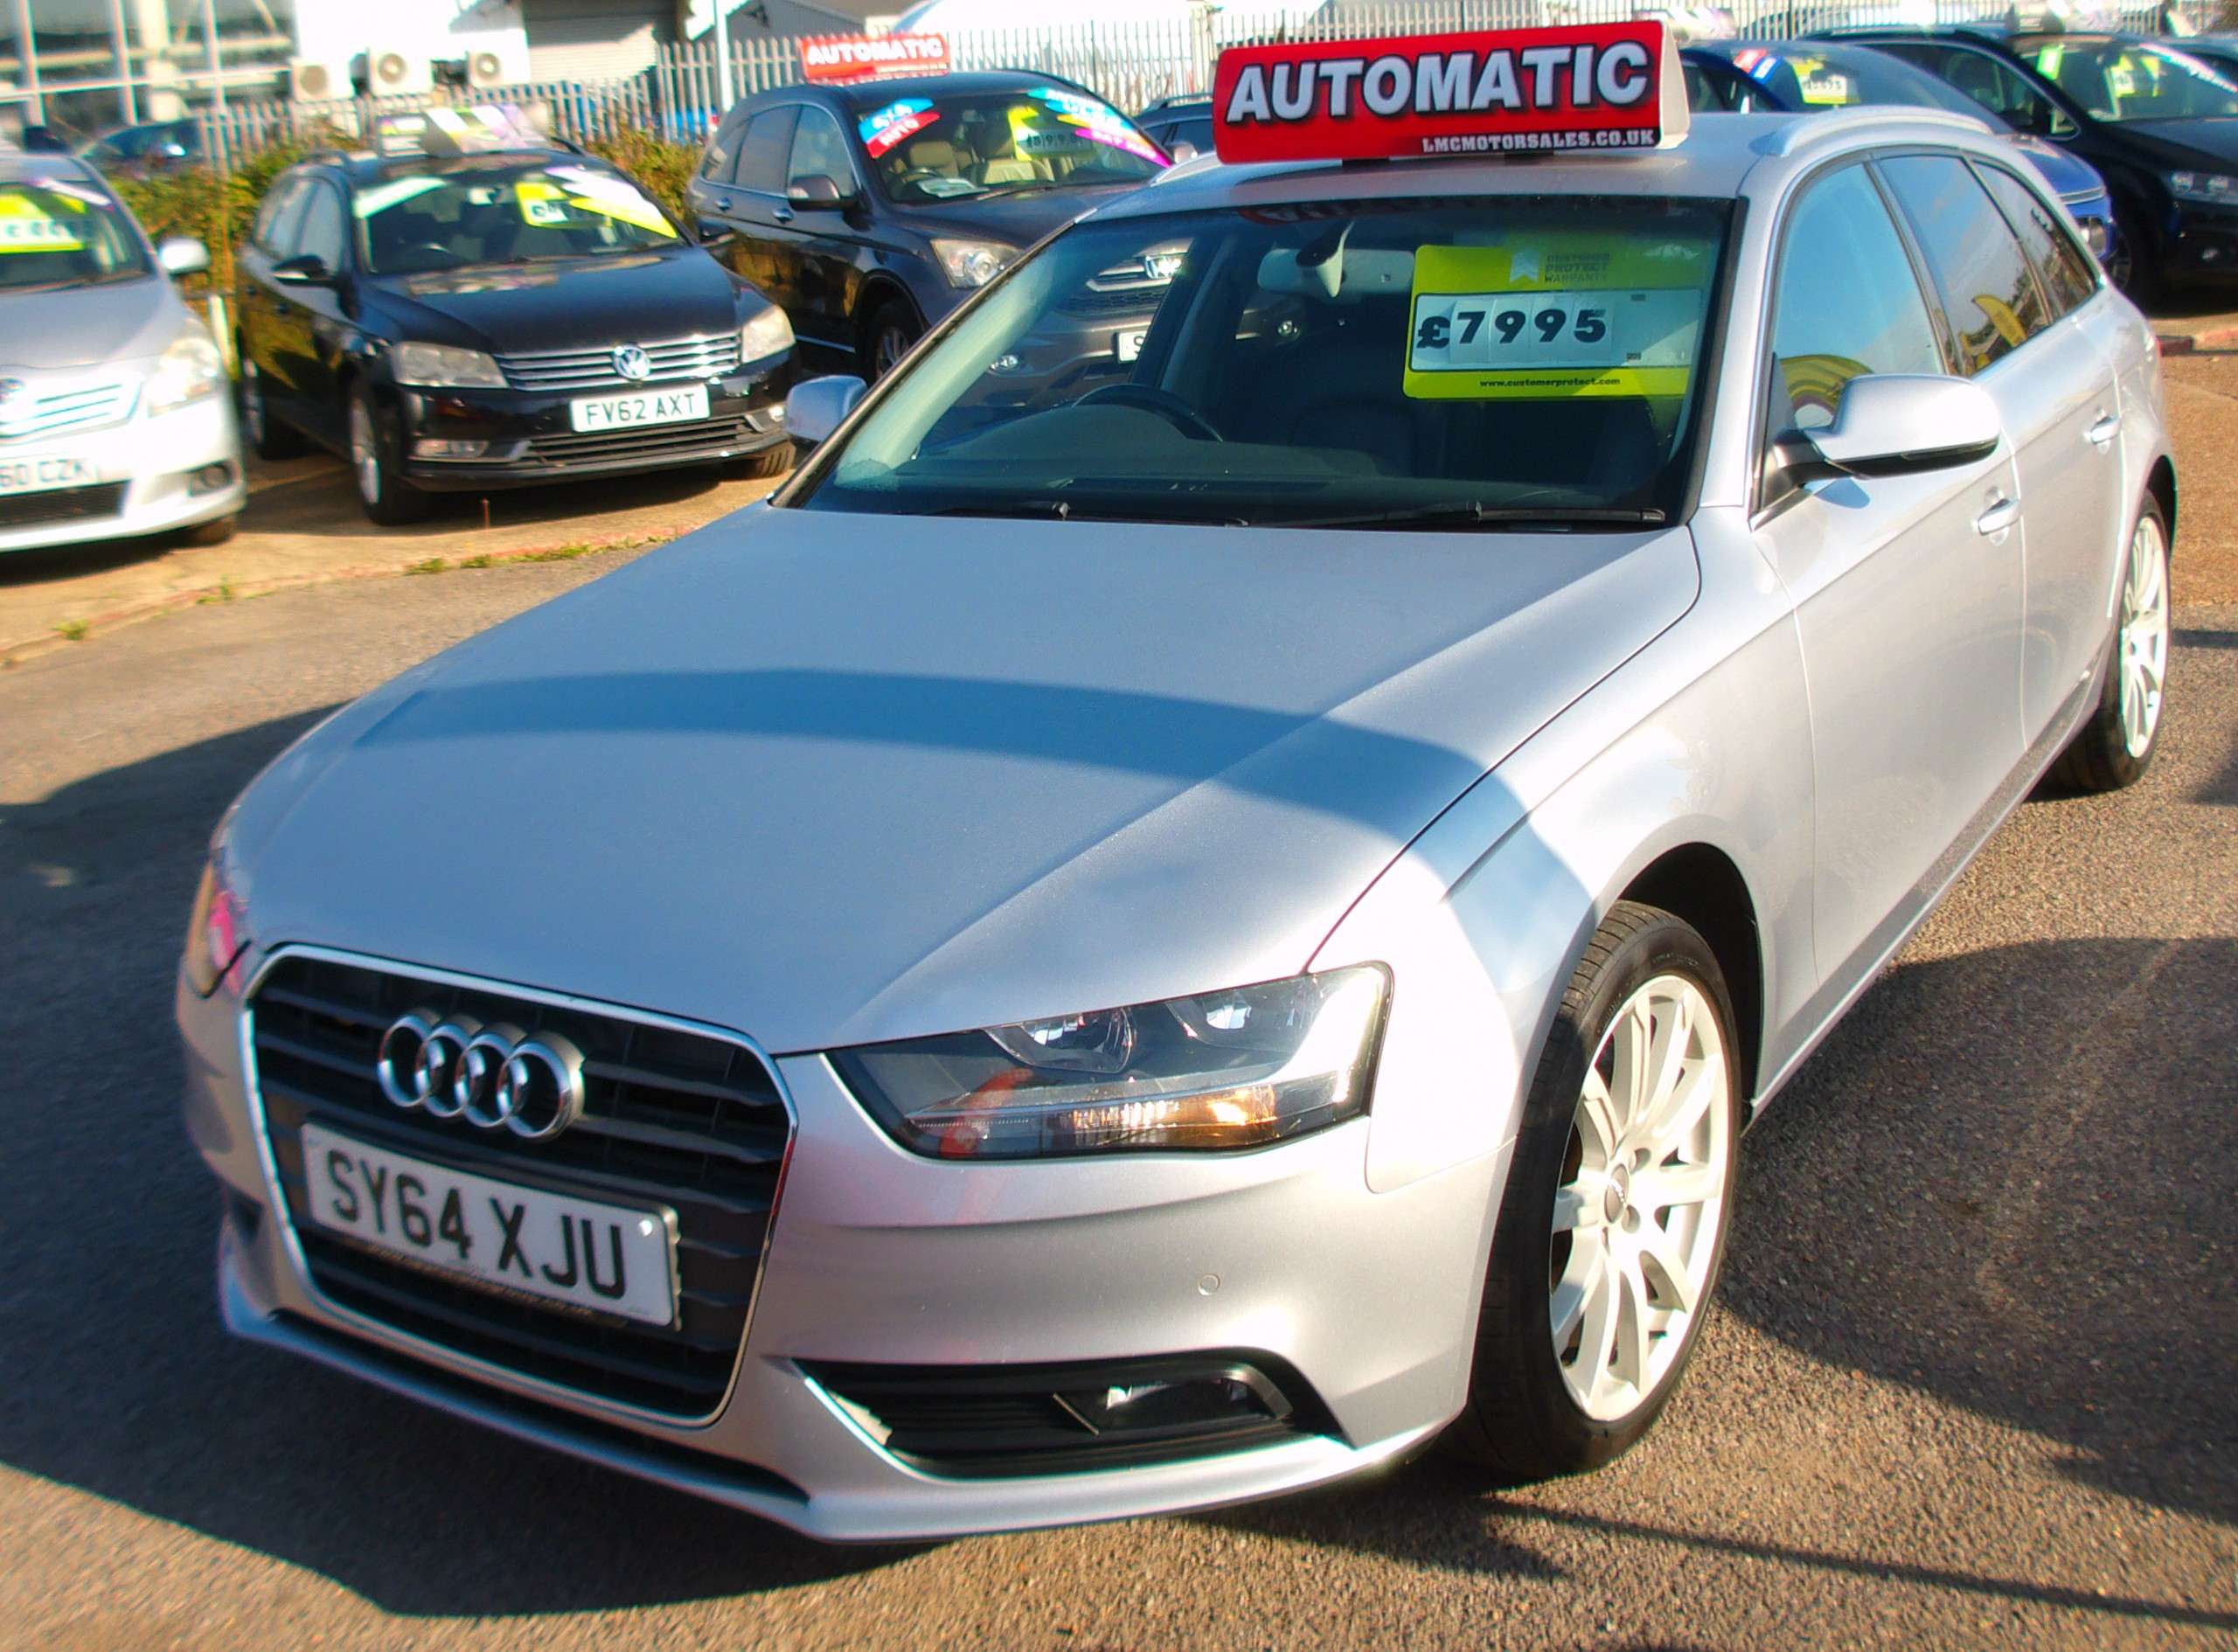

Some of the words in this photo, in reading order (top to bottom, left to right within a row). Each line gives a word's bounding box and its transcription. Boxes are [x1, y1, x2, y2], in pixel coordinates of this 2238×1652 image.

[808, 38, 944, 66] AUTOMATIC
[1226, 41, 1648, 122] AUTOMATIC
[1422, 129, 1655, 153] LMCMOTORSALES.CO.UK
[1416, 309, 1606, 349] £7995
[1480, 377, 1621, 388] www.customerprotect.com
[585, 399, 647, 425] FV62
[656, 393, 695, 418] AXT
[327, 1149, 472, 1260] SY64
[490, 1197, 626, 1301] XJU
